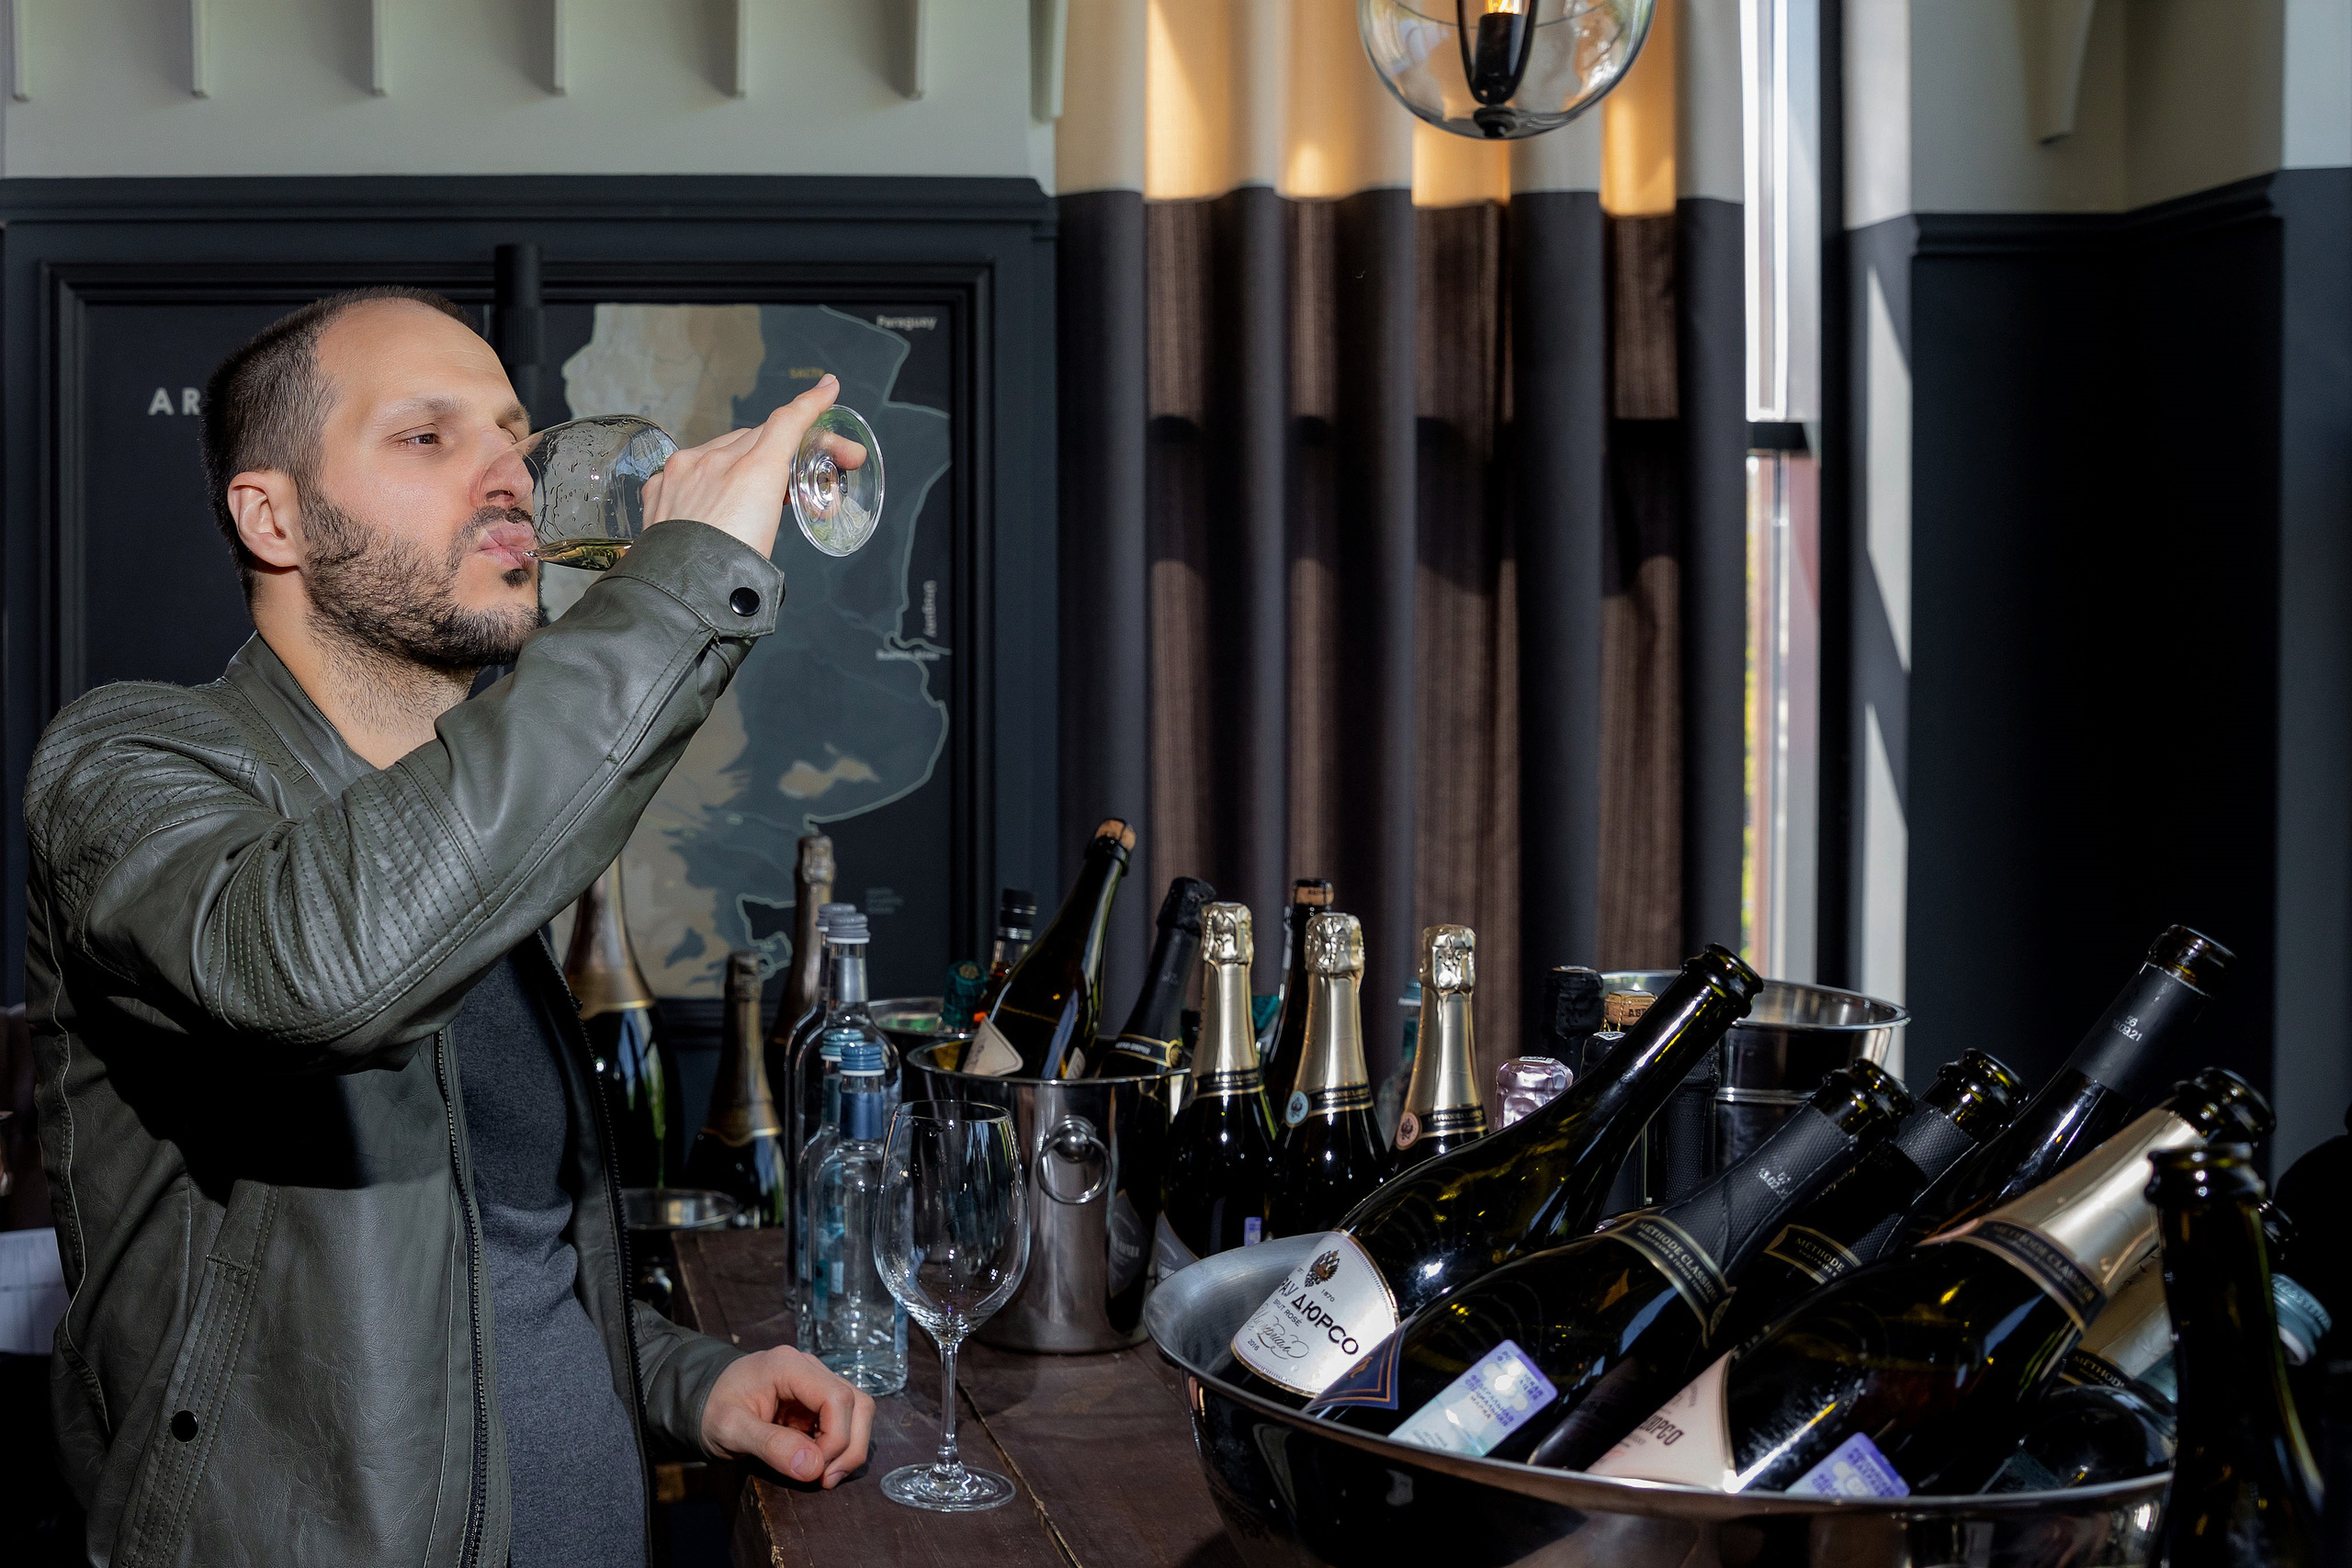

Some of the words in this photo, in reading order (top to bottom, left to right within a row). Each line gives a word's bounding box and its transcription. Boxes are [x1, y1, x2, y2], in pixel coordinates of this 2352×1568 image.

[876, 315, 938, 331] Paraguay
[1320, 1288, 1336, 1303] 1870
[1272, 1298, 1286, 1312] BRUT
[1283, 1309, 1303, 1327] ROSÉ
[1291, 1292, 1360, 1356] ДЮРСО
[1247, 1338, 1261, 1351] 2016
